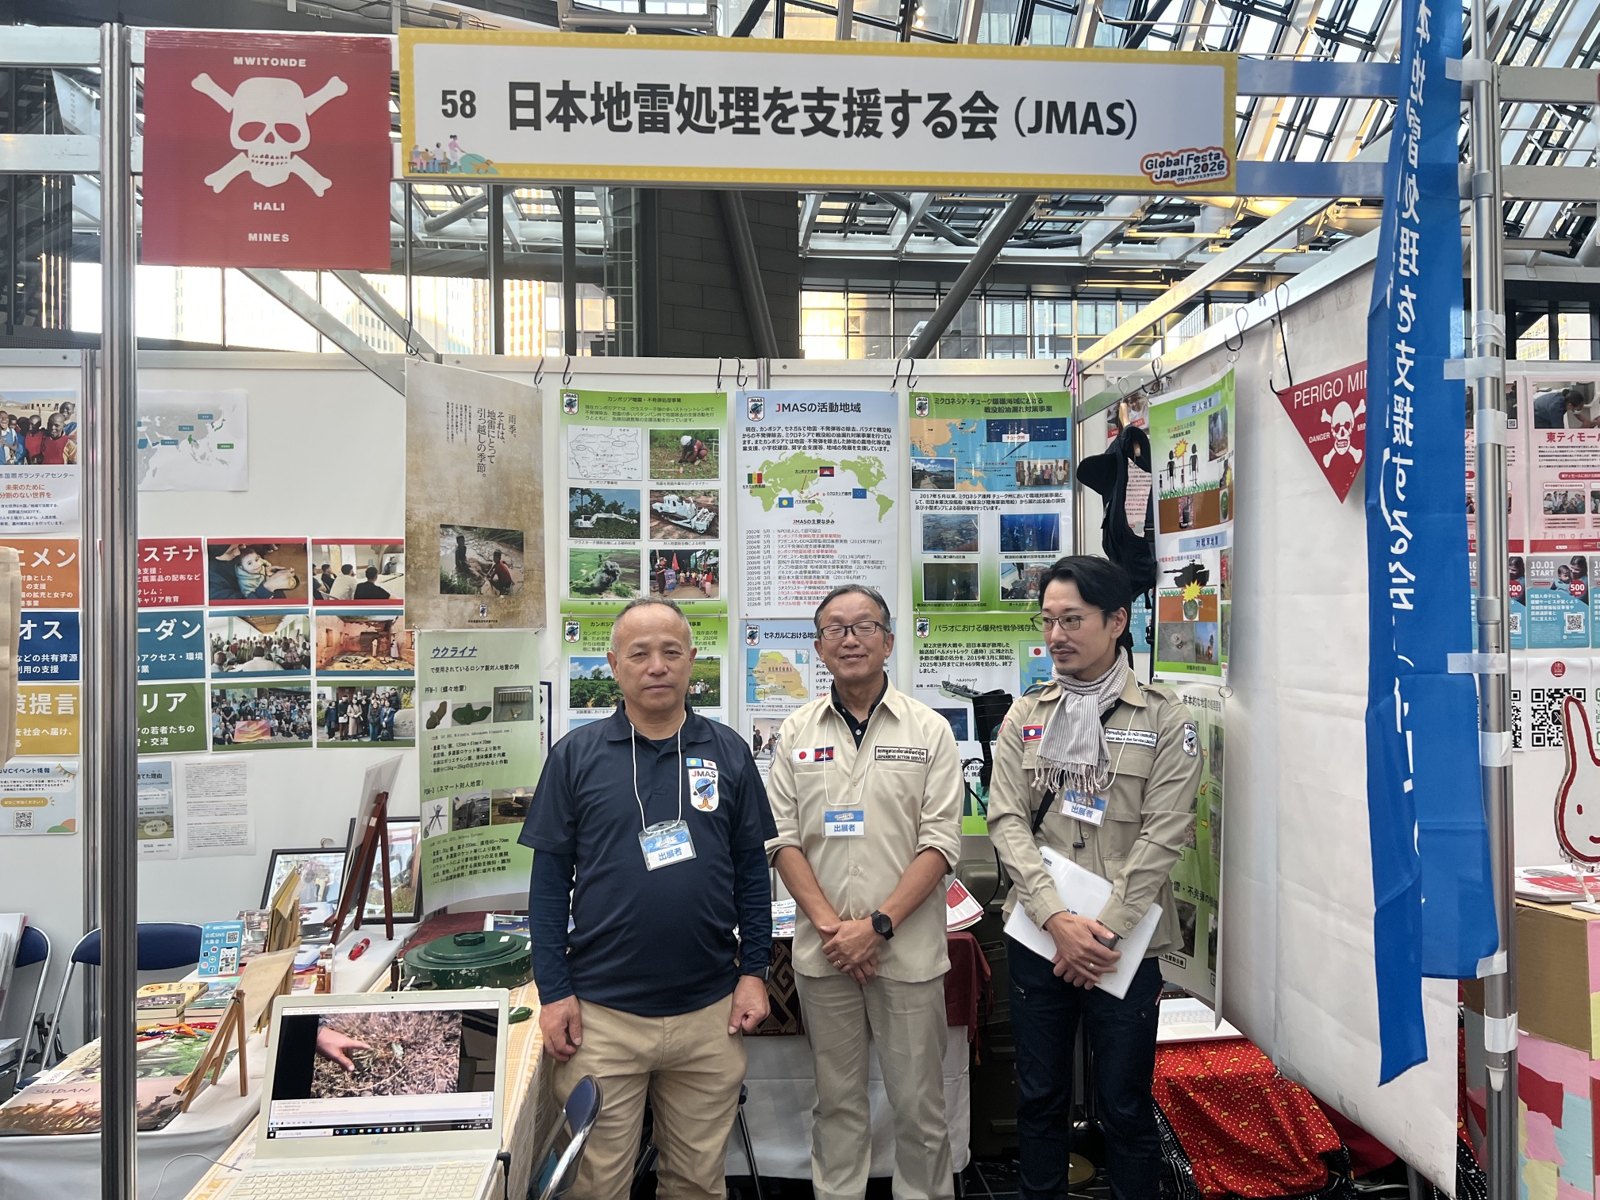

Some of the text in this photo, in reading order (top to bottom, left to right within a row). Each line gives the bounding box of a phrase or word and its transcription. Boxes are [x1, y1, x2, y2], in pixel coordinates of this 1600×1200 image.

[233, 56, 307, 68] MWITONDE
[441, 90, 476, 119] 58
[1145, 152, 1221, 170] Global Festa
[1154, 160, 1225, 180] Japan 2026
[253, 201, 285, 211] HALI
[248, 232, 290, 243] MINES
[1294, 378, 1344, 409] PERIGO
[775, 403, 862, 413] JMASの活動地域
[497, 411, 506, 444] それは、
[487, 409, 496, 464] 地雷にとって
[1309, 432, 1331, 443] DANGER
[477, 408, 486, 478] 引っ越しの季節。
[5, 483, 46, 491] 未来のために
[138, 545, 200, 563] スチナ
[1530, 561, 1555, 569] 10.01
[1570, 584, 1585, 592] 500
[138, 652, 204, 662] アクセス・環境
[432, 646, 478, 658] ウクライナ
[142, 692, 188, 713] リア
[692, 770, 717, 778] JMAS
[1071, 805, 1094, 819] 出展者
[834, 824, 856, 832] 出展者
[658, 847, 682, 861] 出展者
[32, 1087, 92, 1096] SUDAN
